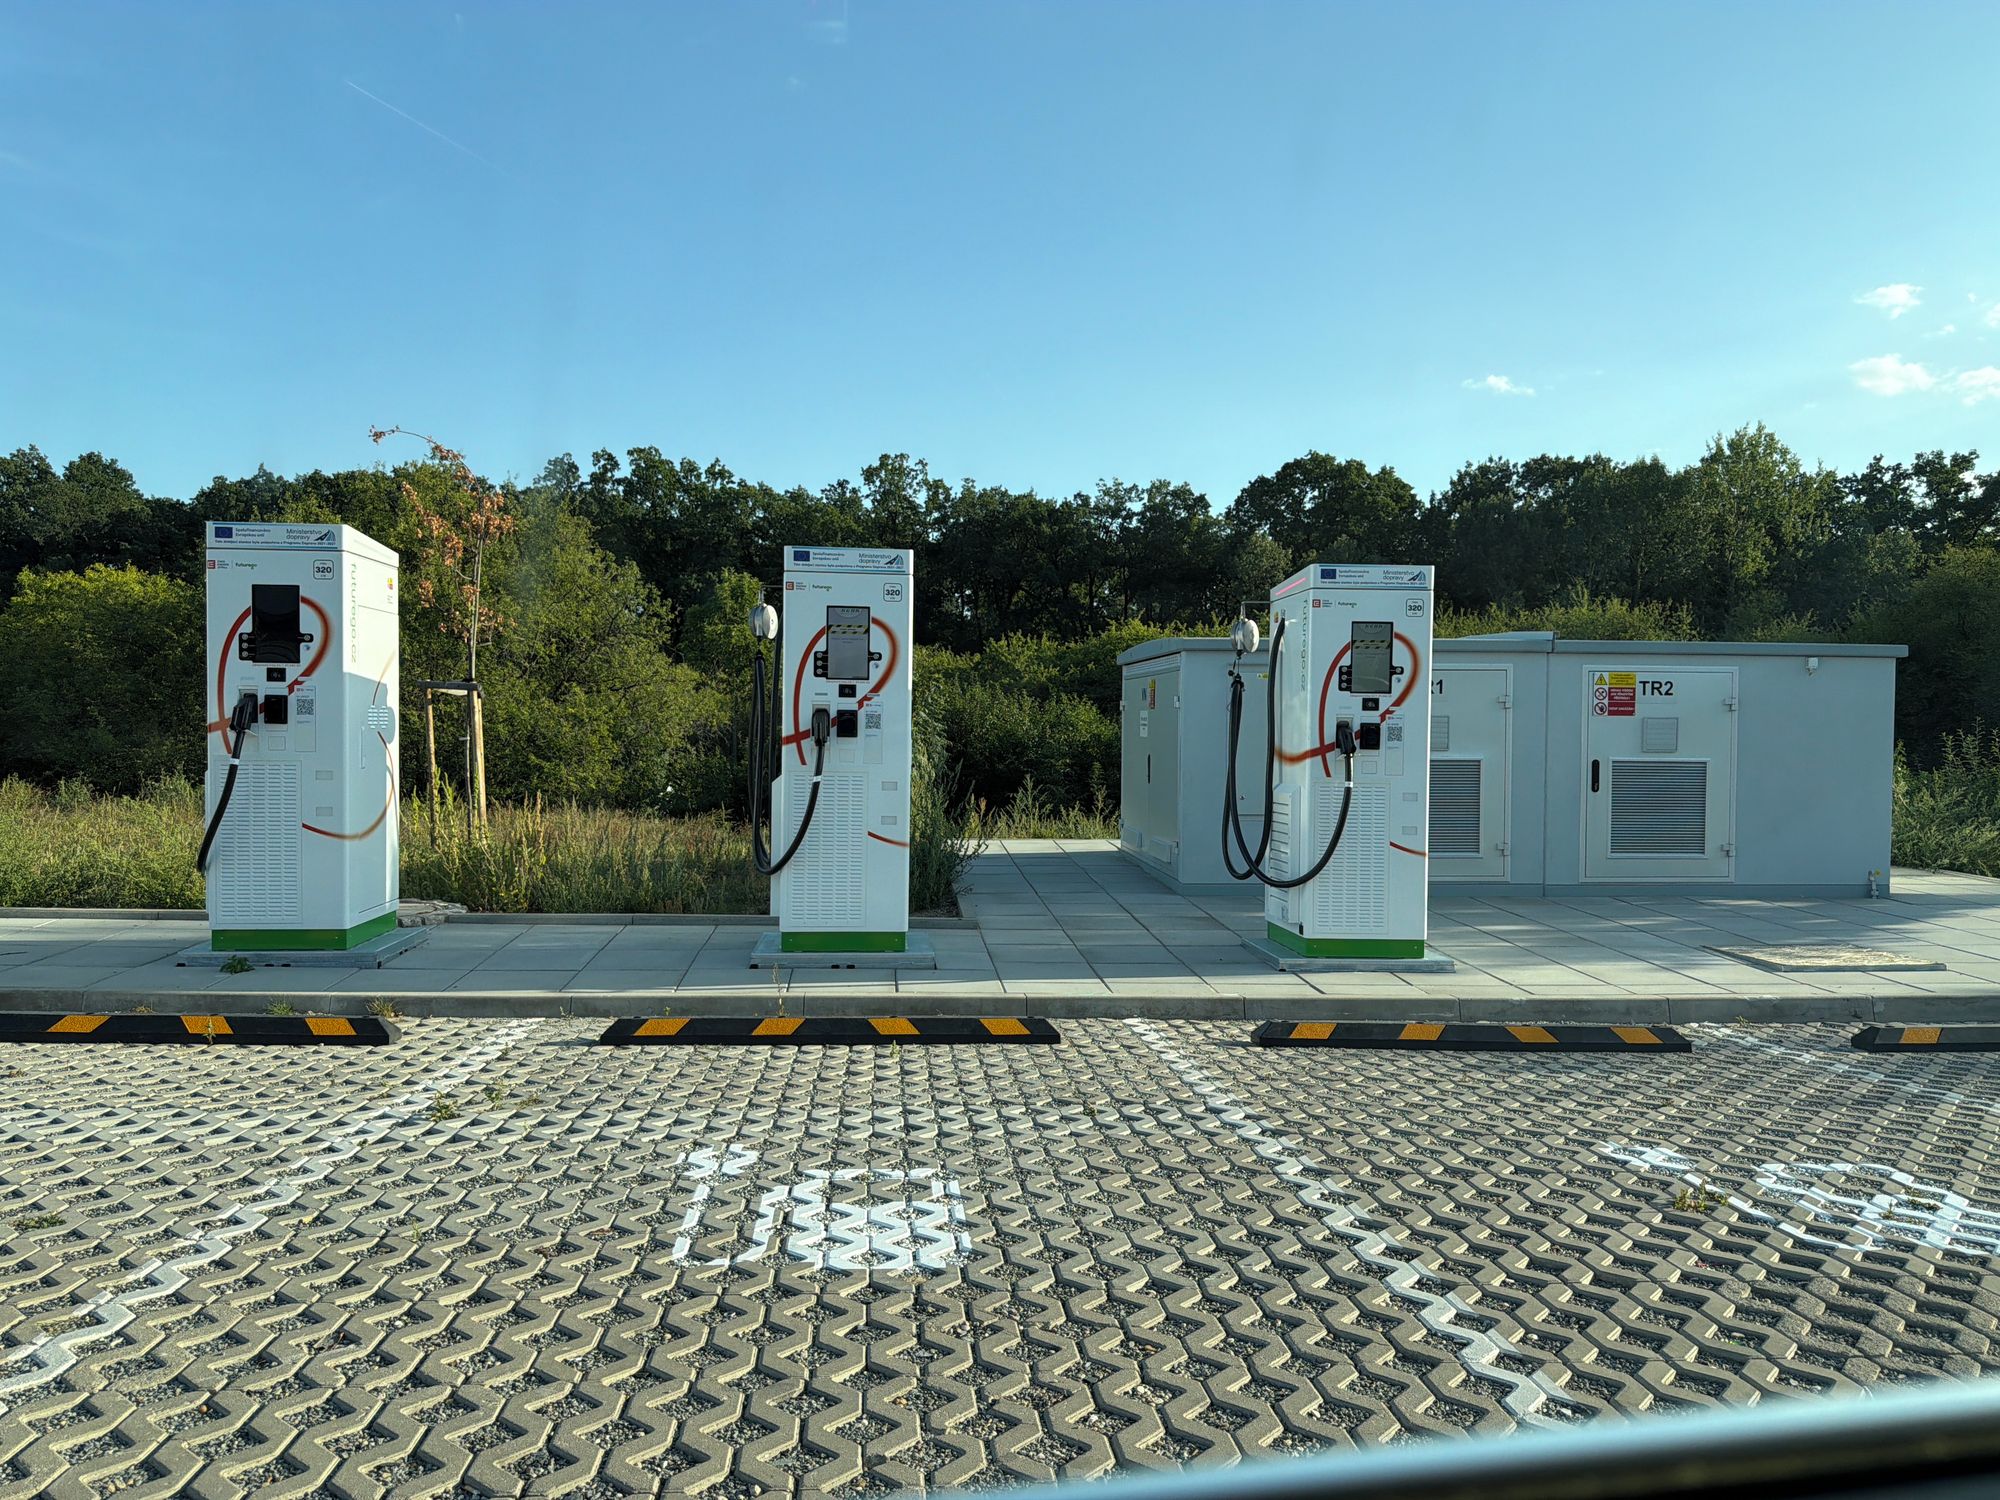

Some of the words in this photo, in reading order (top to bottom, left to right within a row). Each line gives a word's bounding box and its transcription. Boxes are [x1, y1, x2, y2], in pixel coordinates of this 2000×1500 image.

[315, 566, 332, 574] 320
[1407, 604, 1422, 612] 320
[1639, 680, 1673, 696] TR2
